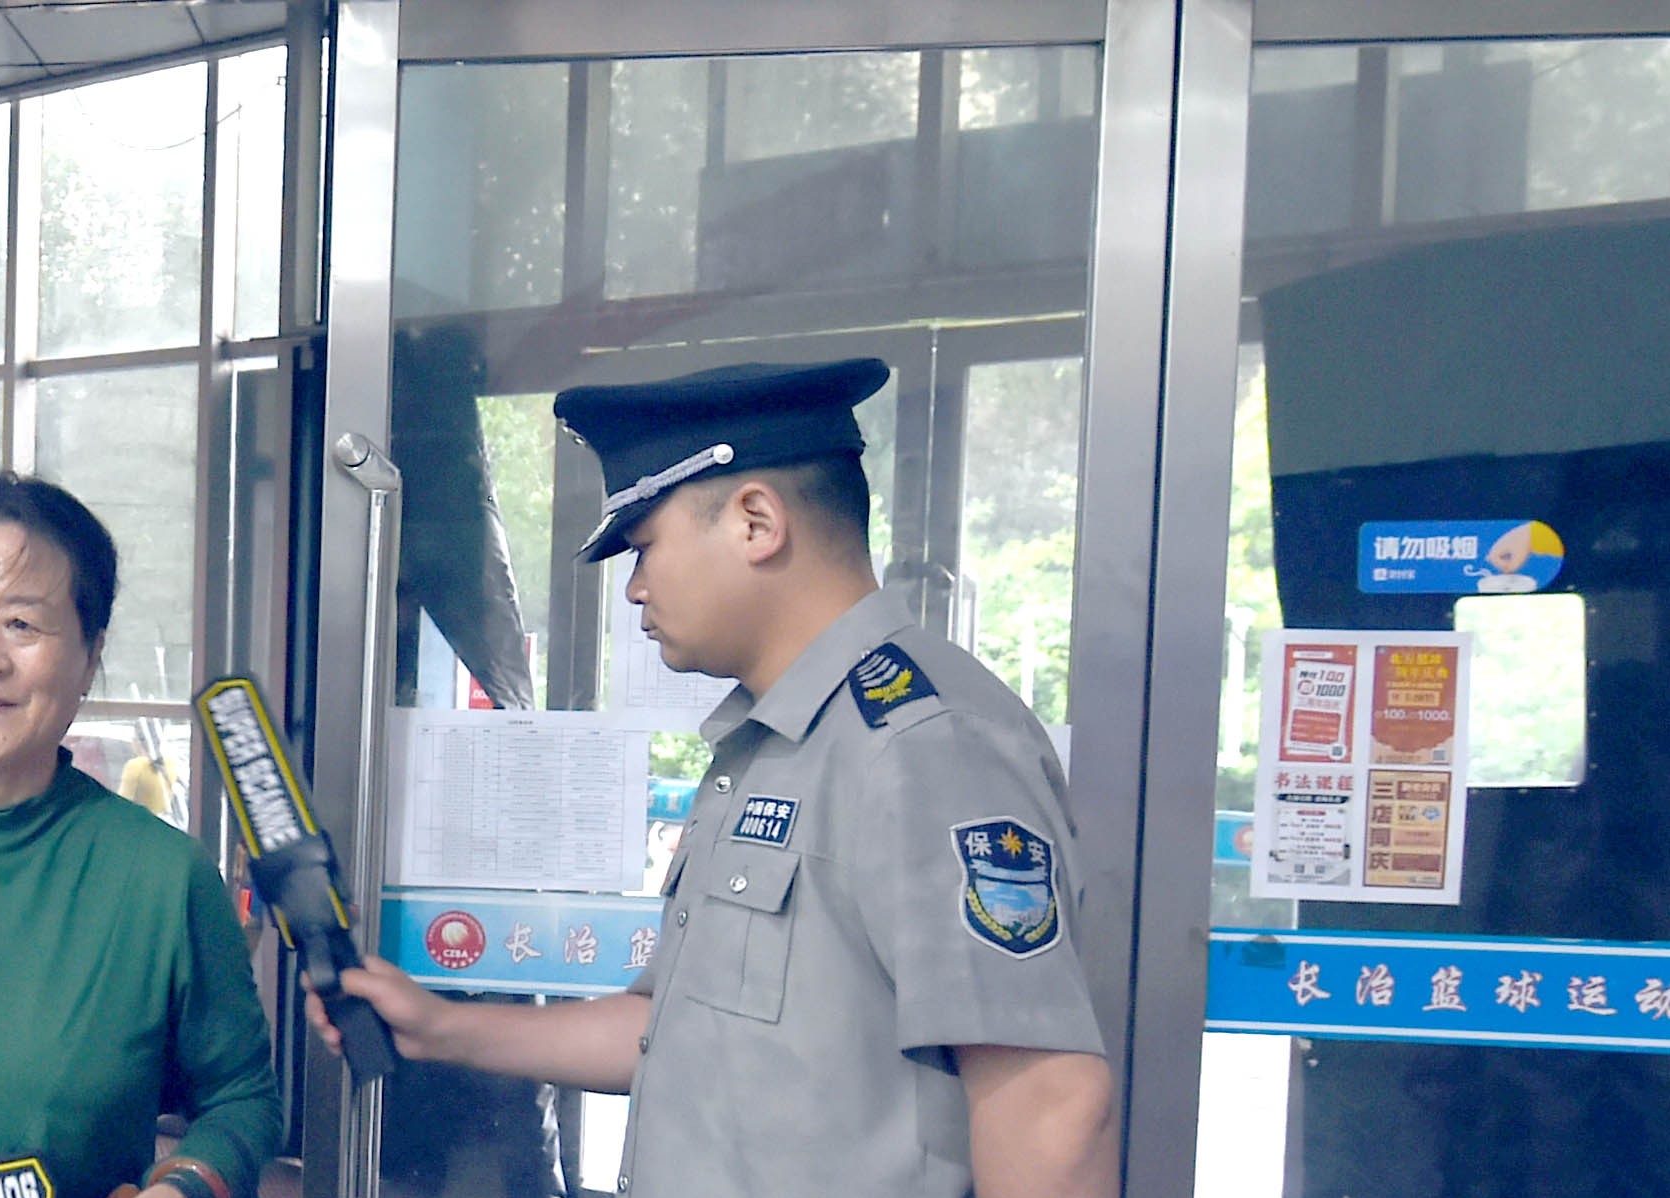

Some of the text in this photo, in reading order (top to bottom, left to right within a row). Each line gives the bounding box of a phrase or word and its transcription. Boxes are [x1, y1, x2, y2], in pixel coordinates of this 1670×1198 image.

[1374, 536, 1478, 560] 请勿吸烟
[207, 687, 268, 767] SUPER
[1274, 770, 1354, 791] 书法课程
[1369, 781, 1394, 870] 三店同庆
